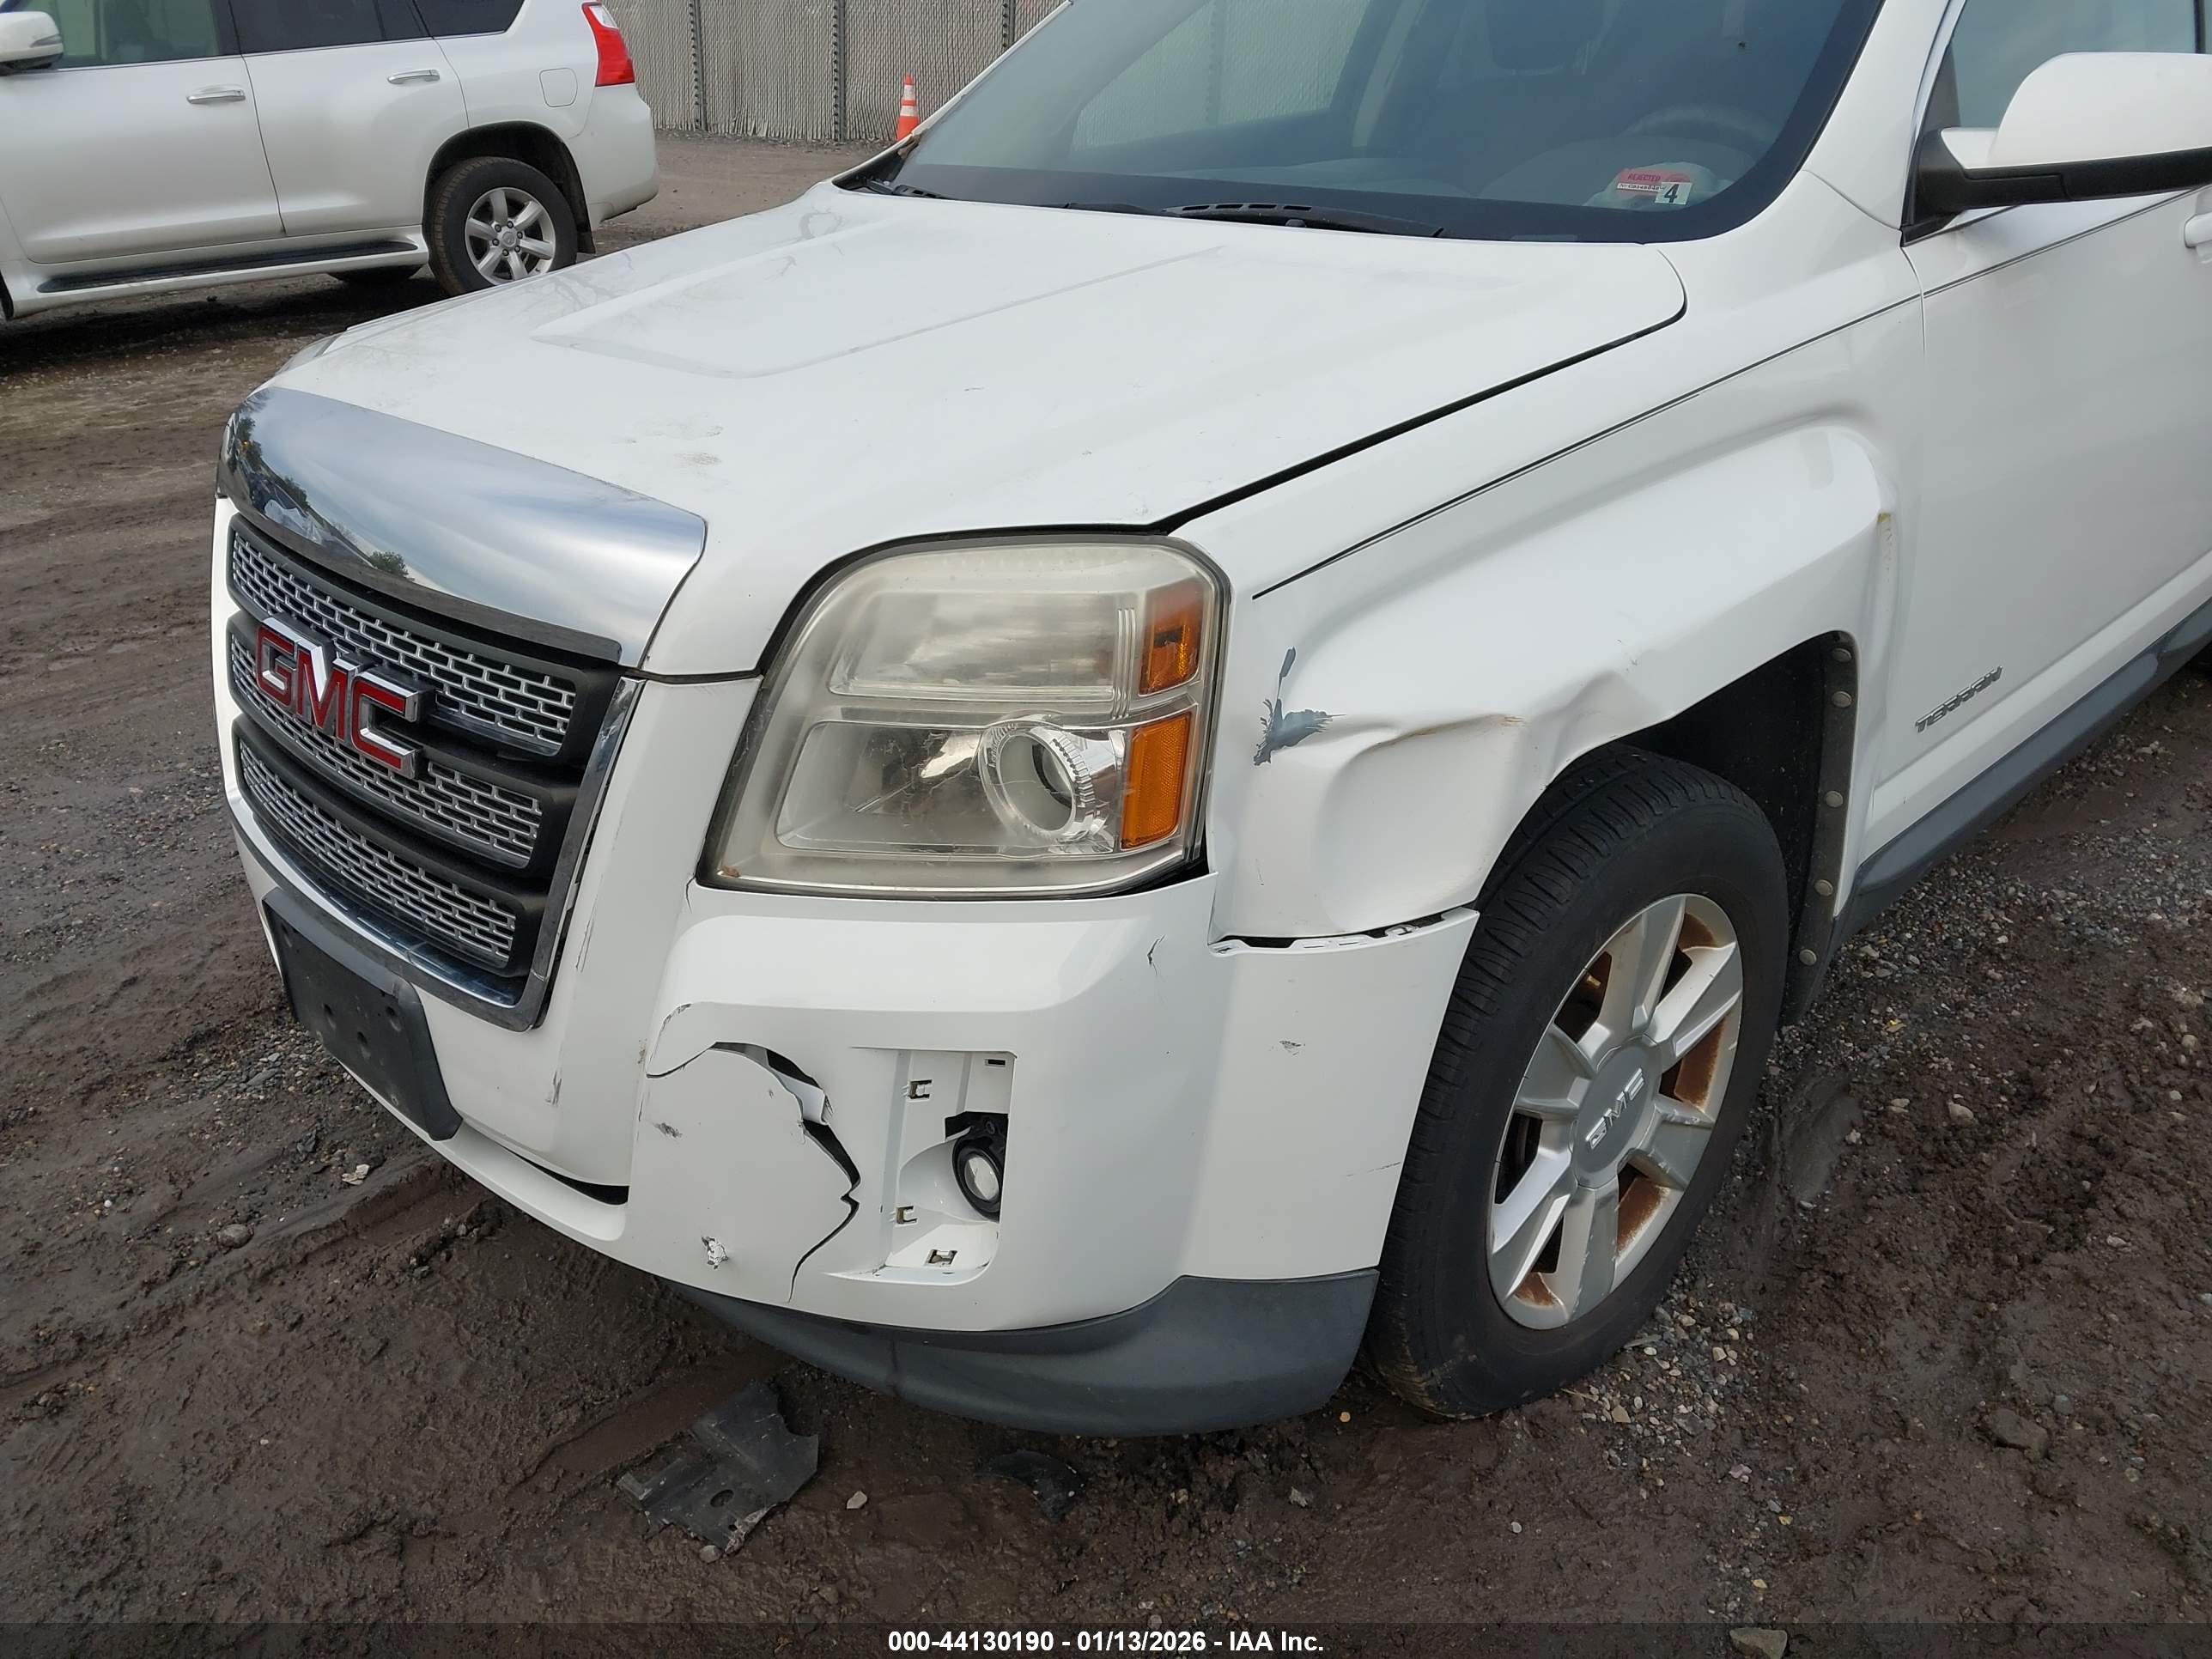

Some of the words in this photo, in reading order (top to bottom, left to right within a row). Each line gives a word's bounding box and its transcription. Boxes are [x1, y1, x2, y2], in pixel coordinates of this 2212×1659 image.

[1664, 183, 1680, 204] 4
[257, 617, 419, 780] GMC
[1915, 666, 2002, 733] TERRAIN
[1585, 1067, 1644, 1150] GMC
